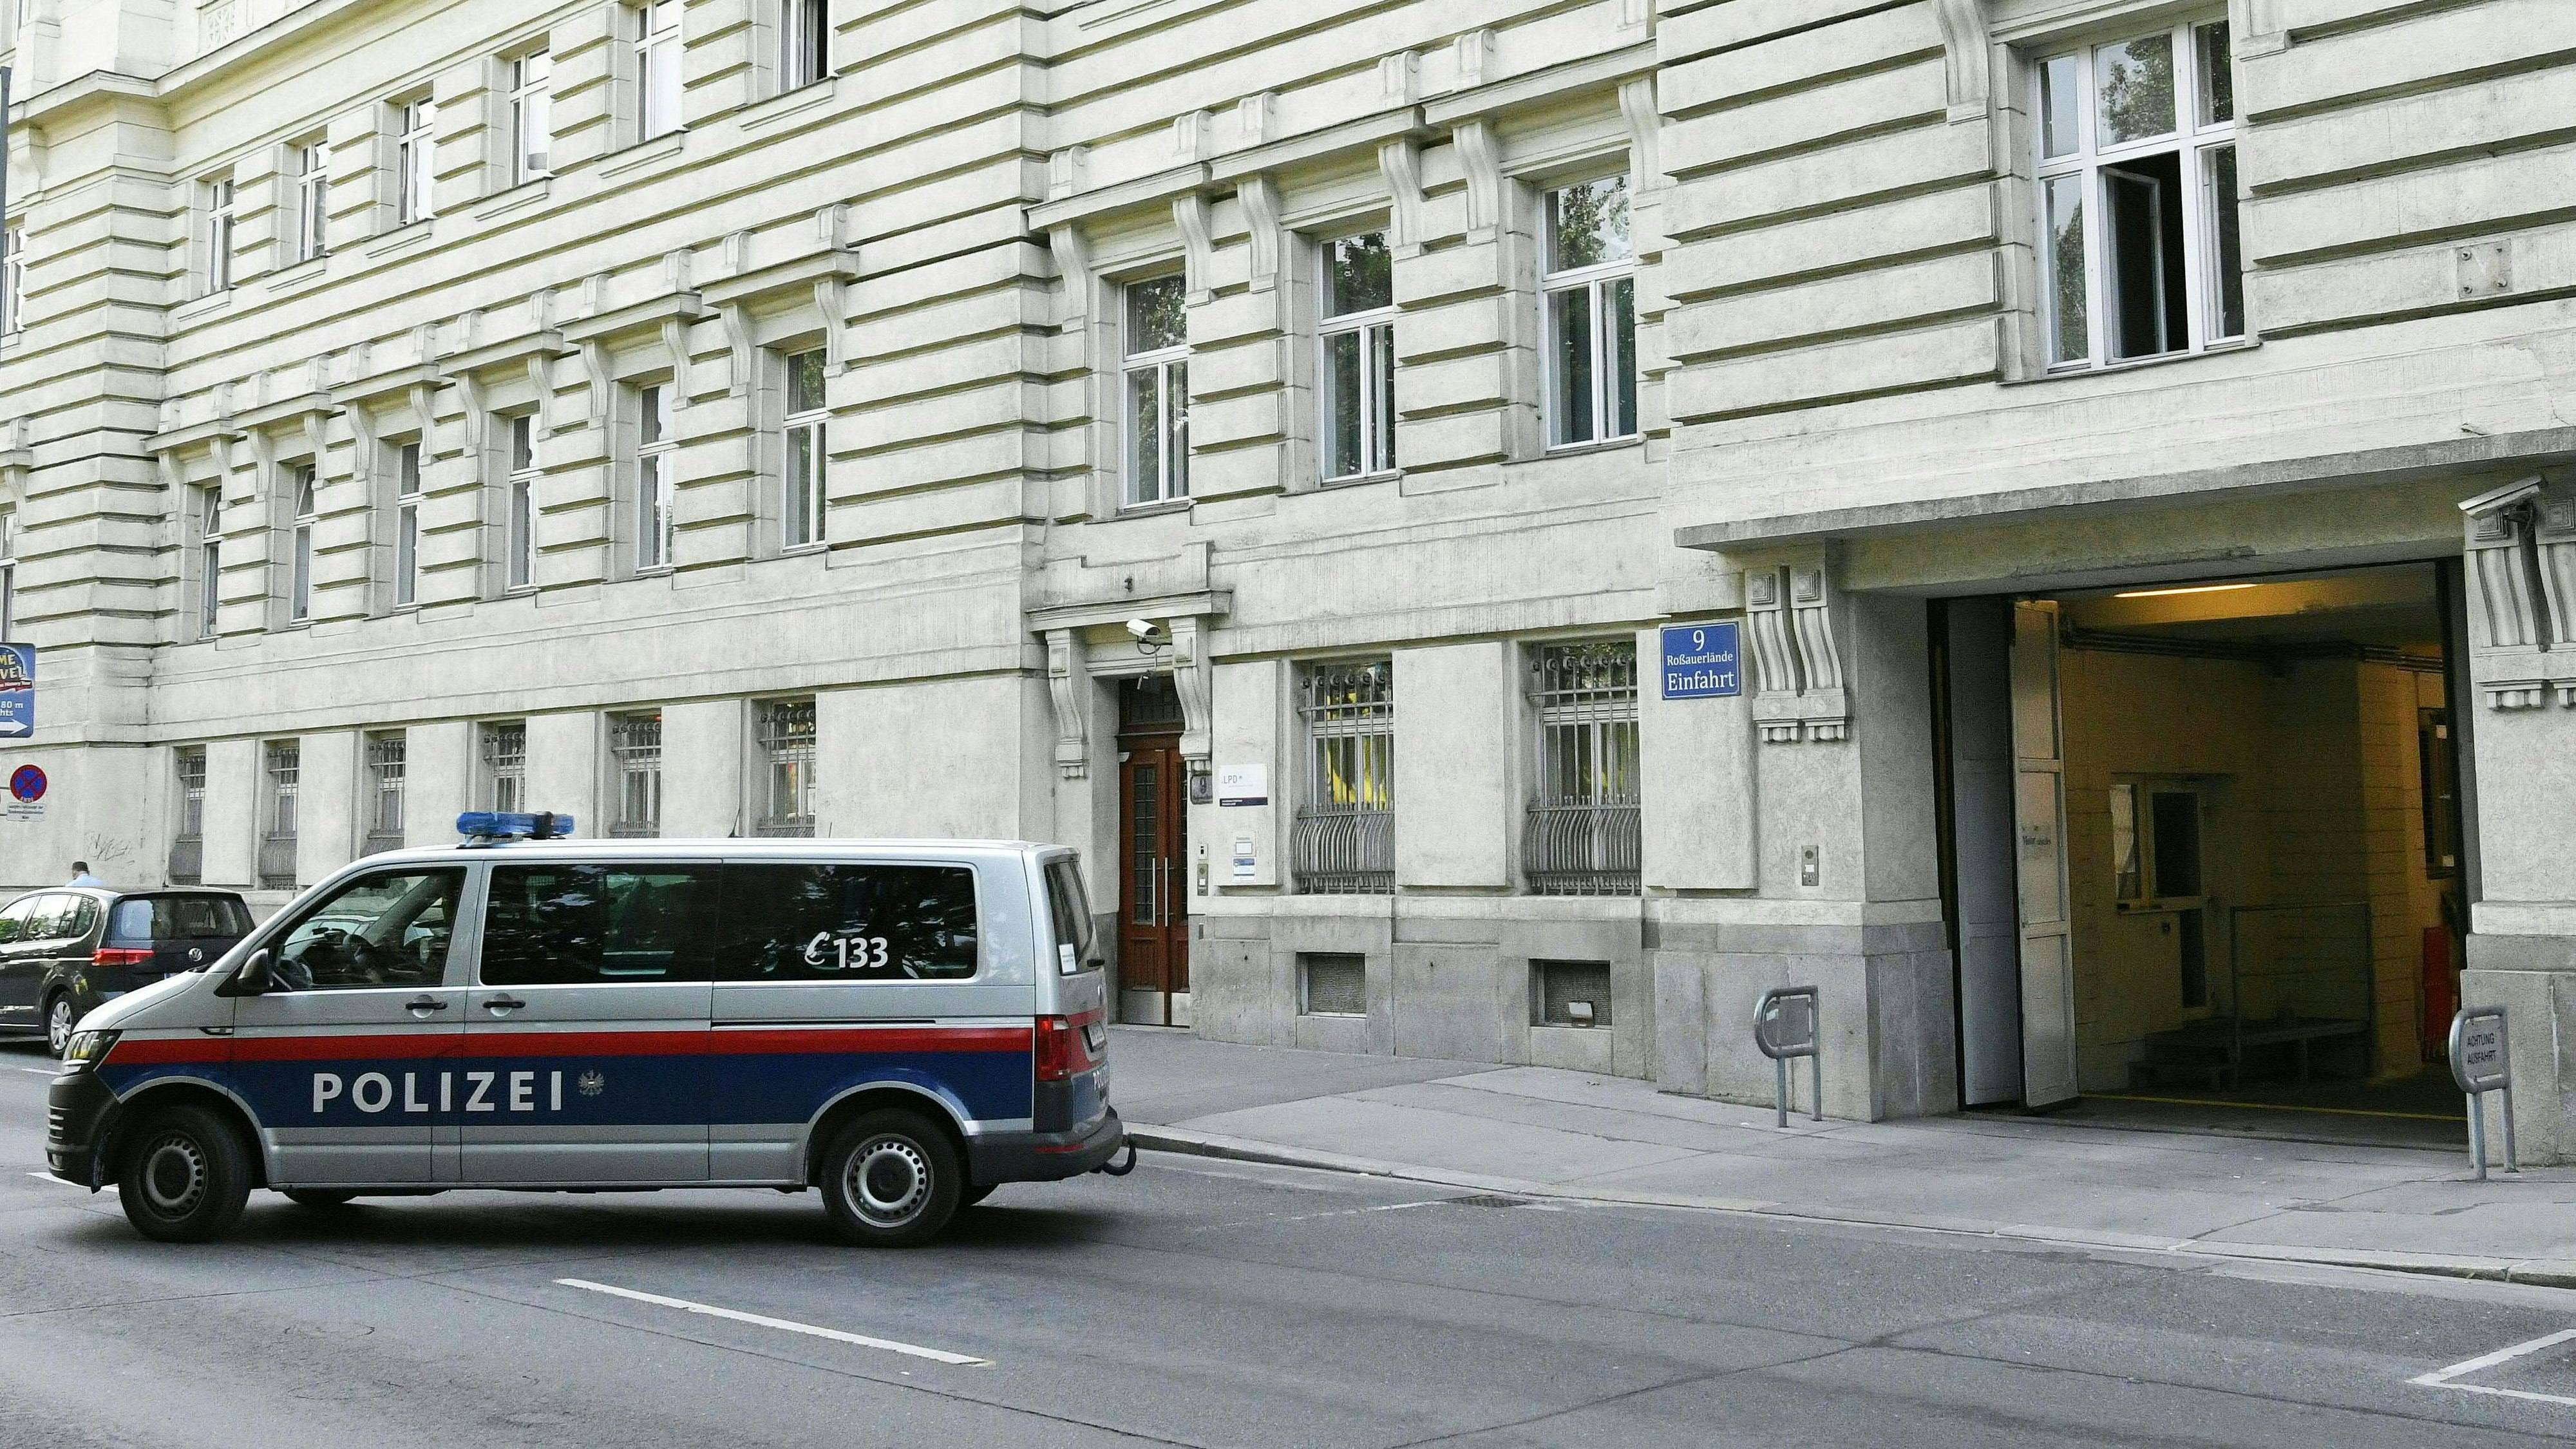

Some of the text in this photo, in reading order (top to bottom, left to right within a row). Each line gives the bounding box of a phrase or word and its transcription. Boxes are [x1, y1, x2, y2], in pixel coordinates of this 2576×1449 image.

[1692, 630, 1705, 652] 9
[1667, 650, 1733, 666] Roßauerlände
[1667, 670, 1735, 691] Einfahrt
[833, 937, 888, 968] 133
[2467, 1032, 2494, 1047] ACHTUNG
[2467, 1050, 2496, 1065] AUSFAHRT
[313, 1071, 562, 1113] POLIZEI
